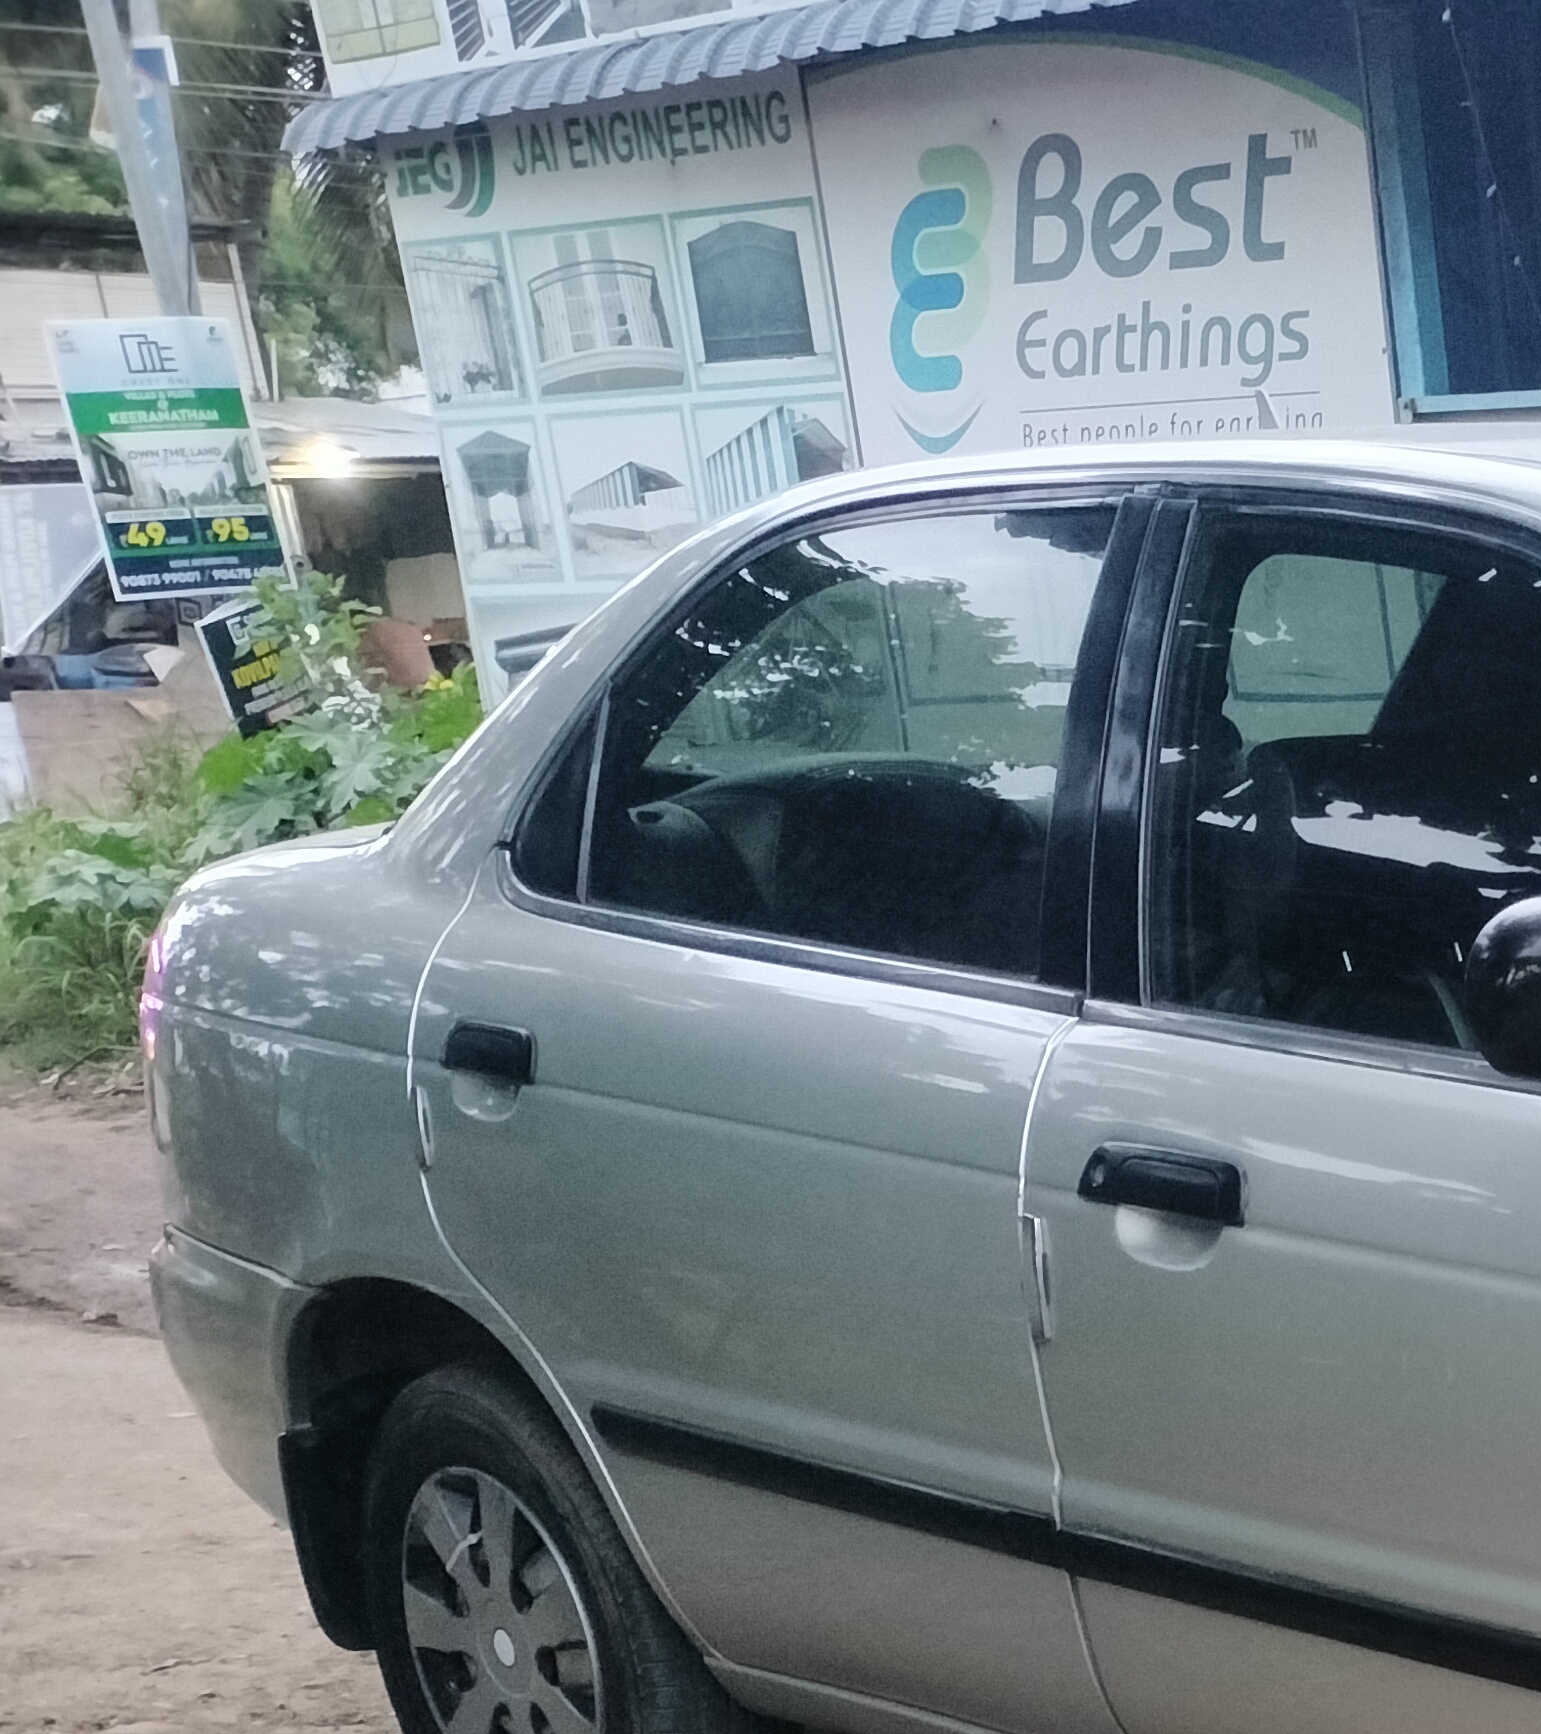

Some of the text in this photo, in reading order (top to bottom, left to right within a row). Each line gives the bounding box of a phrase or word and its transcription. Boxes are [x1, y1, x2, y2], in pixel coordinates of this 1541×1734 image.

[512, 90, 792, 176] JAI ENGINEERING
[1013, 132, 1292, 285] Best
[1016, 300, 1310, 388] Earthings
[108, 409, 219, 425] KEERANATHAM
[1022, 422, 1068, 448] Best
[1170, 412, 1203, 436] for
[128, 447, 222, 460] OWN THE LAND
[128, 522, 166, 546] 49
[211, 517, 249, 542] 95
